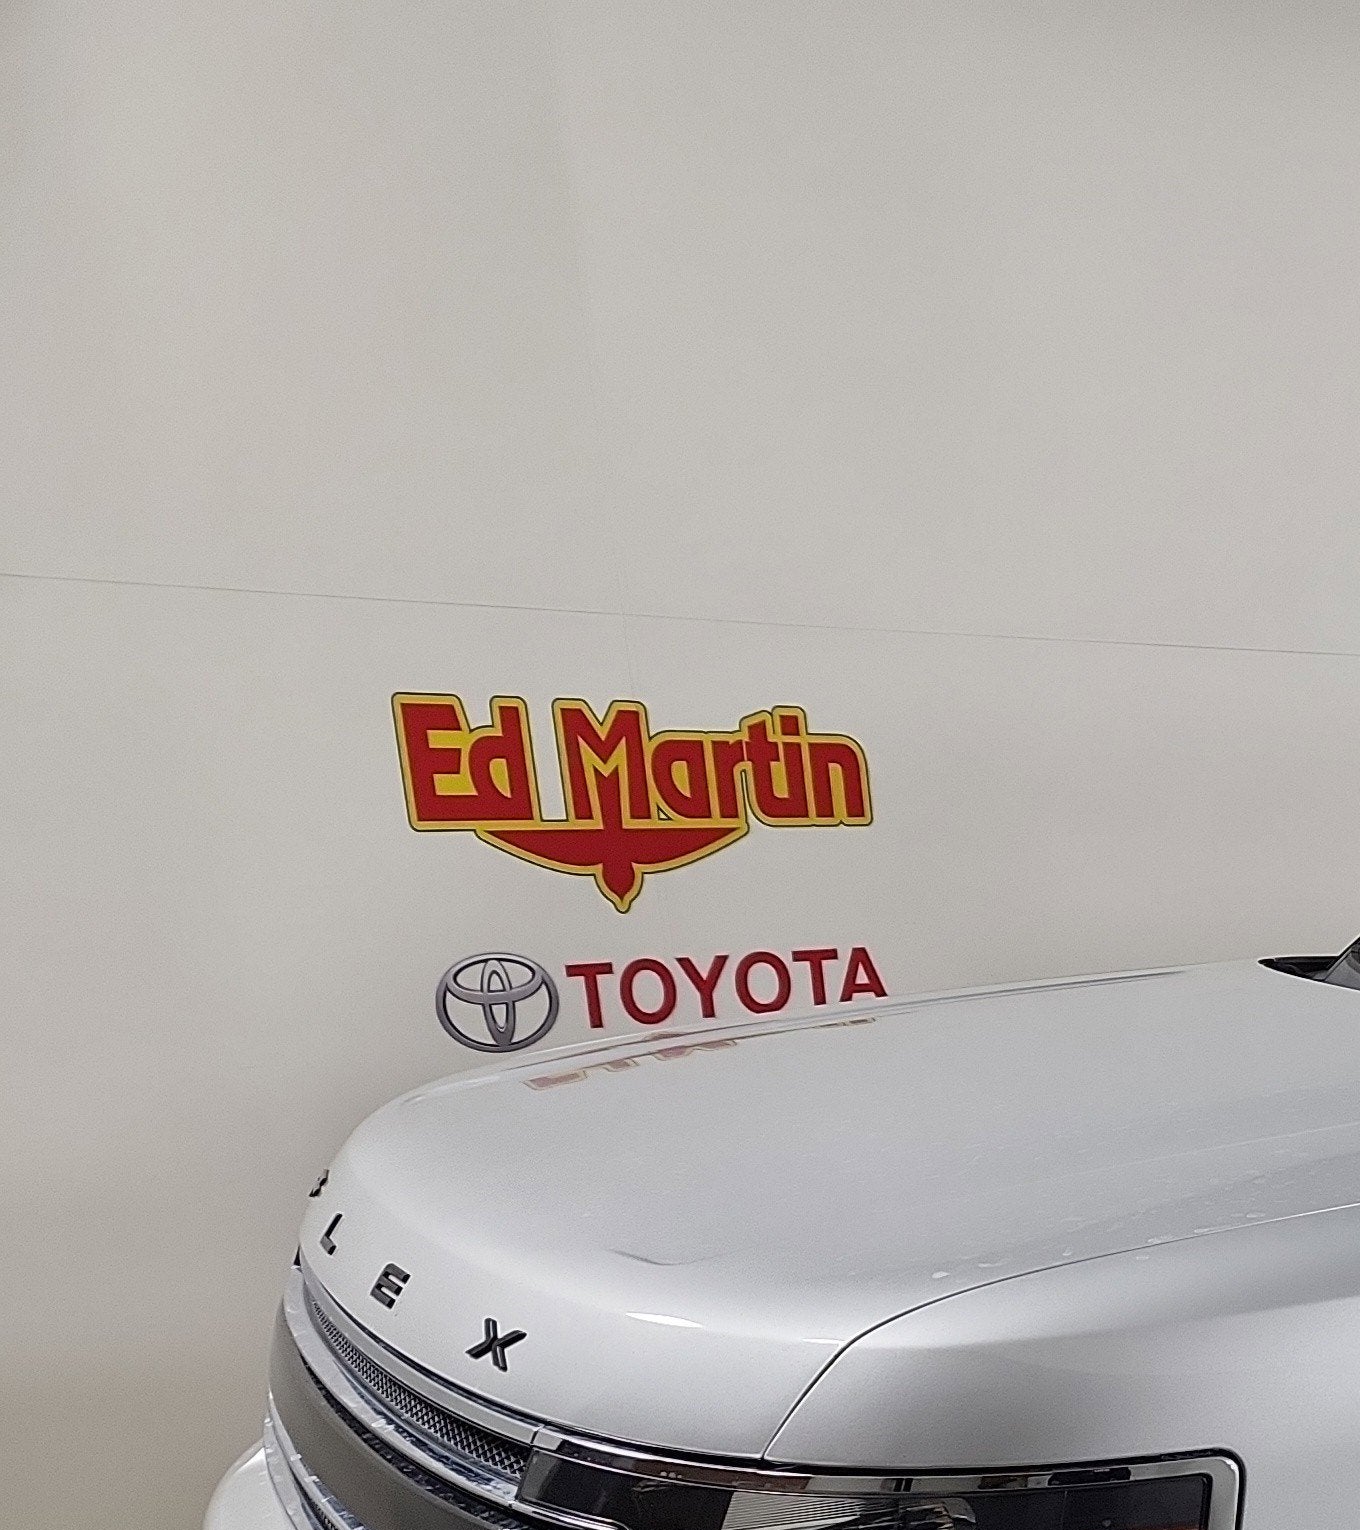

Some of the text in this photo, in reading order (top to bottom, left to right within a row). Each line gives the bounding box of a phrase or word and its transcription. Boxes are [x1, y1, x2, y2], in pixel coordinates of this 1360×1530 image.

[392, 692, 873, 831] Ed Martin
[565, 946, 888, 1029] TOYOTA
